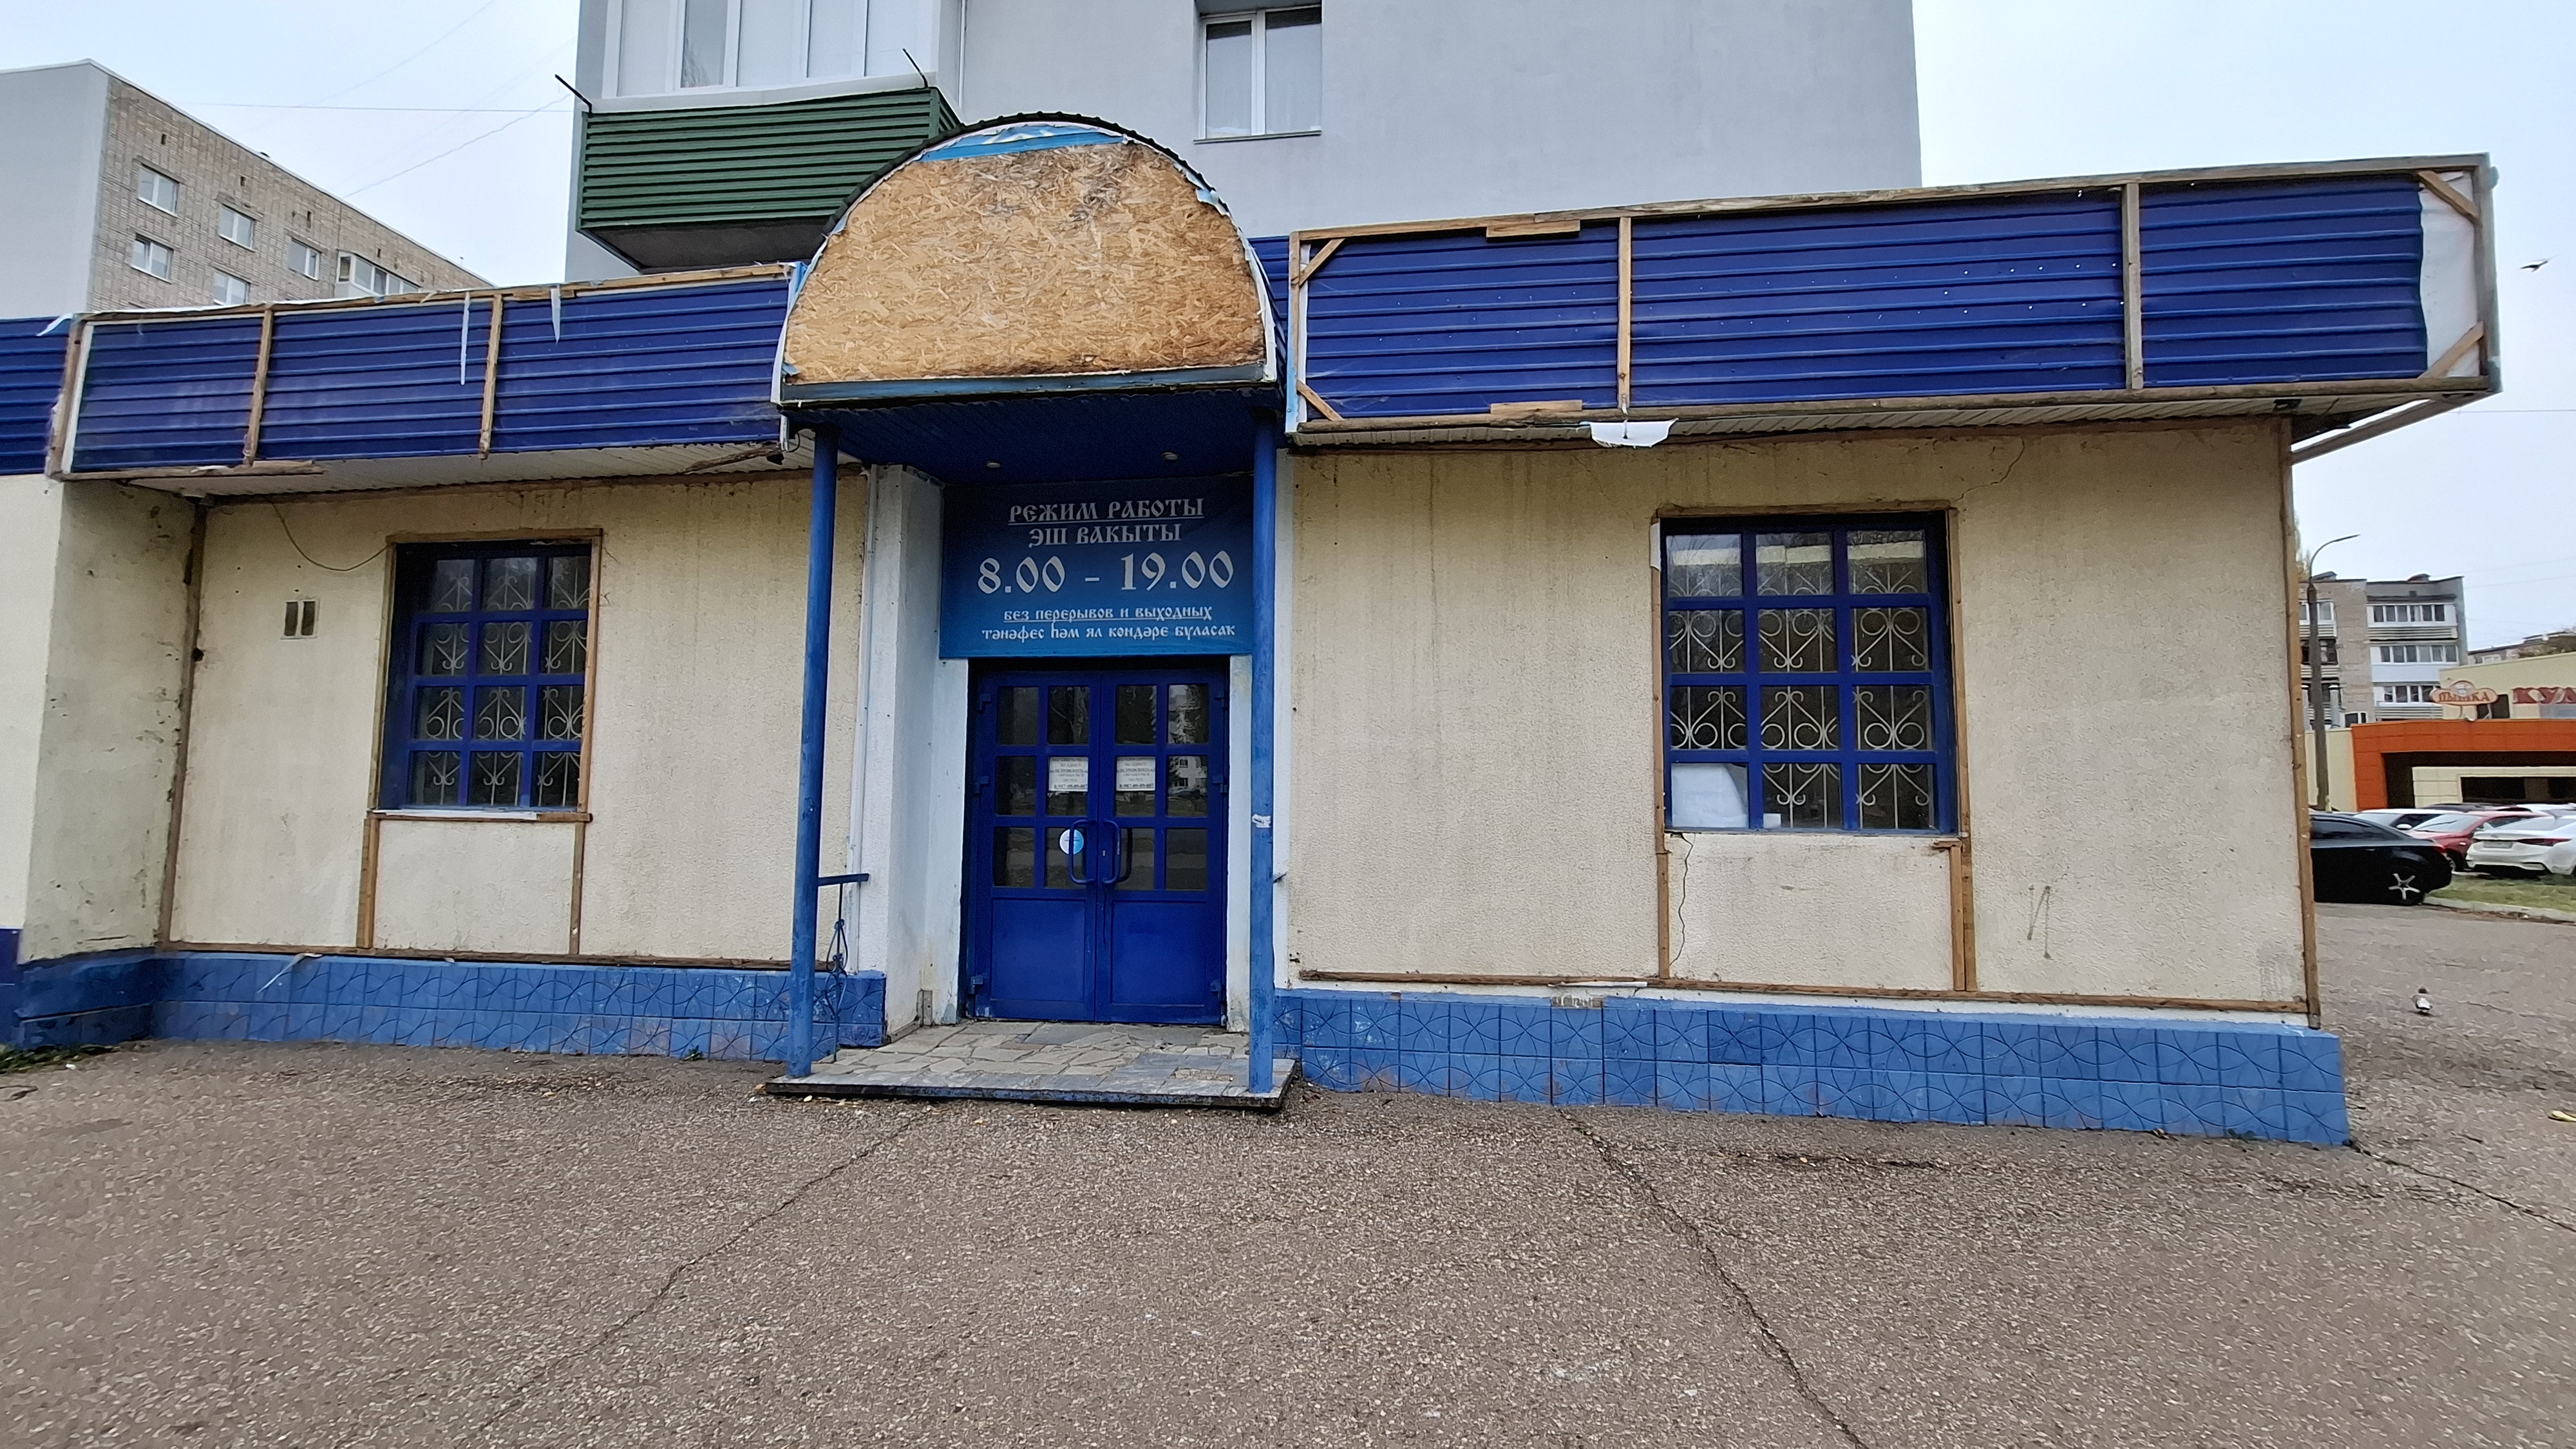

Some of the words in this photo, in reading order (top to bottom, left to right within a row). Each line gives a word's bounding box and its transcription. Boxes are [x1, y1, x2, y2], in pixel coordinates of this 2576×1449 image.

[1008, 502, 1099, 522] РЕЖИМ
[1107, 498, 1204, 518] РАБОТЫ
[1028, 528, 1068, 548] ЭШ
[1075, 523, 1182, 545] ВАКЫТЫ
[978, 556, 1066, 594] 8.00
[1120, 550, 1235, 591] 19.00
